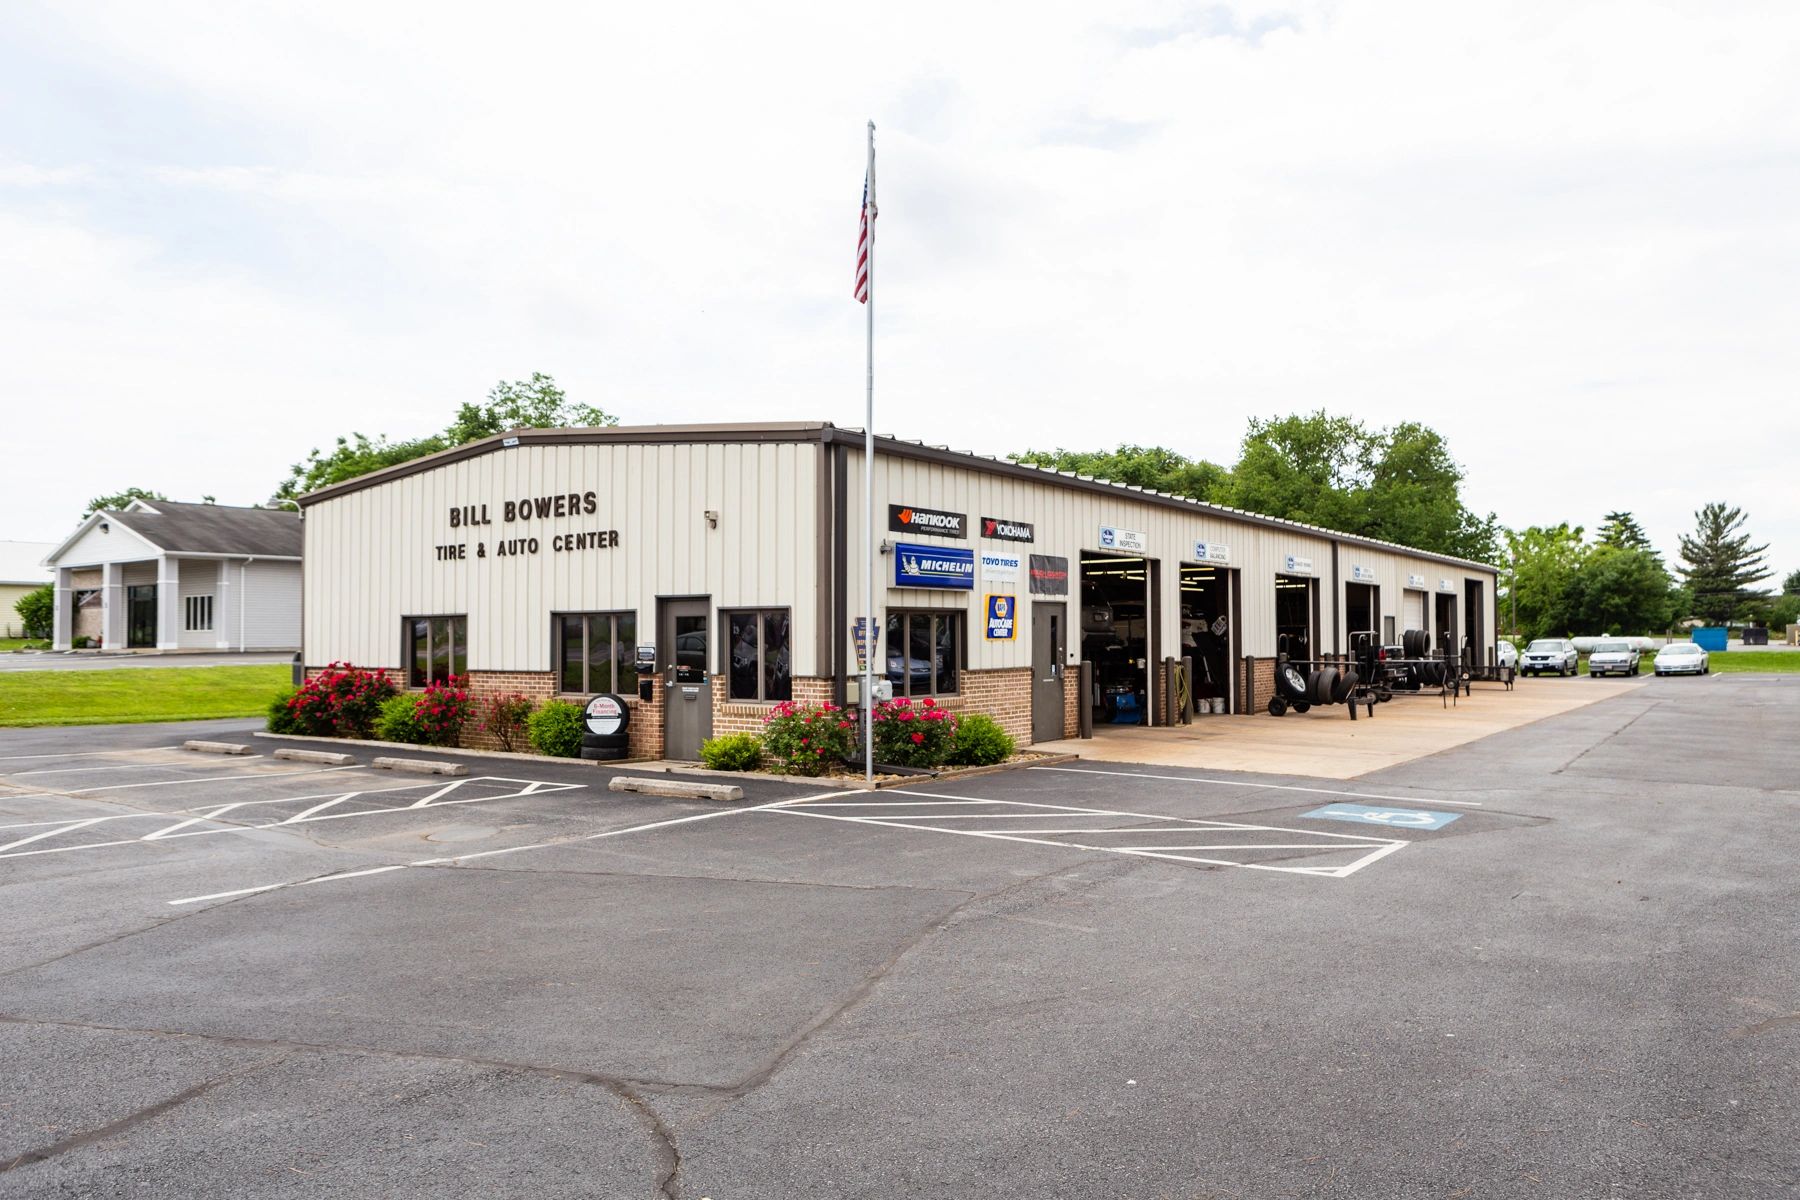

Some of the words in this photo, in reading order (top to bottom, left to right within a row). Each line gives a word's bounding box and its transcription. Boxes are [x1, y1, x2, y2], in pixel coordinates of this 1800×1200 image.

[450, 503, 491, 528] BILL
[504, 491, 598, 523] BOWERS
[996, 523, 1032, 539] YOKOHAMA
[1125, 532, 1136, 541] STATE
[435, 543, 467, 561] TIRE
[477, 542, 487, 559] &
[497, 537, 540, 557] AUTO
[552, 530, 620, 553] CENTER
[1119, 539, 1142, 550] INSPECTION
[920, 559, 973, 573] MICHELIN
[982, 556, 1000, 566] TOYO
[1000, 558, 1019, 568] TIRES
